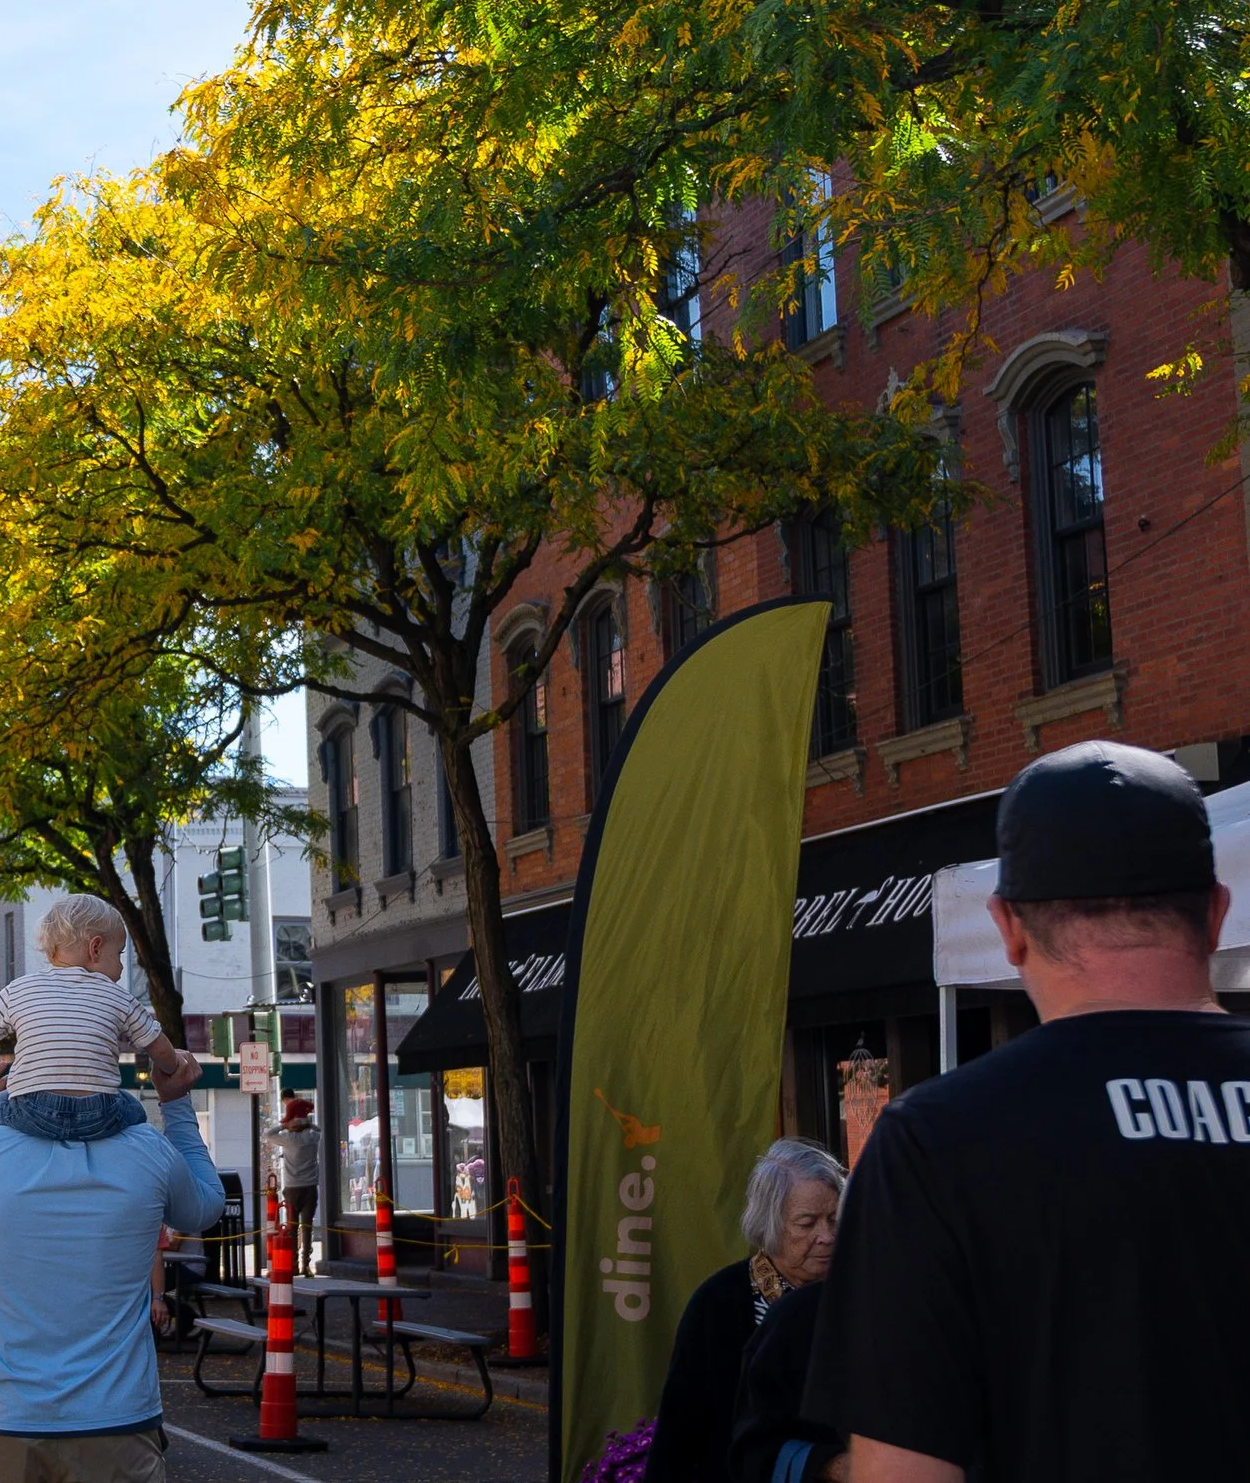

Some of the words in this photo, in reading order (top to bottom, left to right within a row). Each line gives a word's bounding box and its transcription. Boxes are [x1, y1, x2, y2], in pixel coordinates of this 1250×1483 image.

[250, 1052, 259, 1060] NO
[242, 1065, 267, 1075] STOPPING
[599, 1155, 657, 1323] dine.
